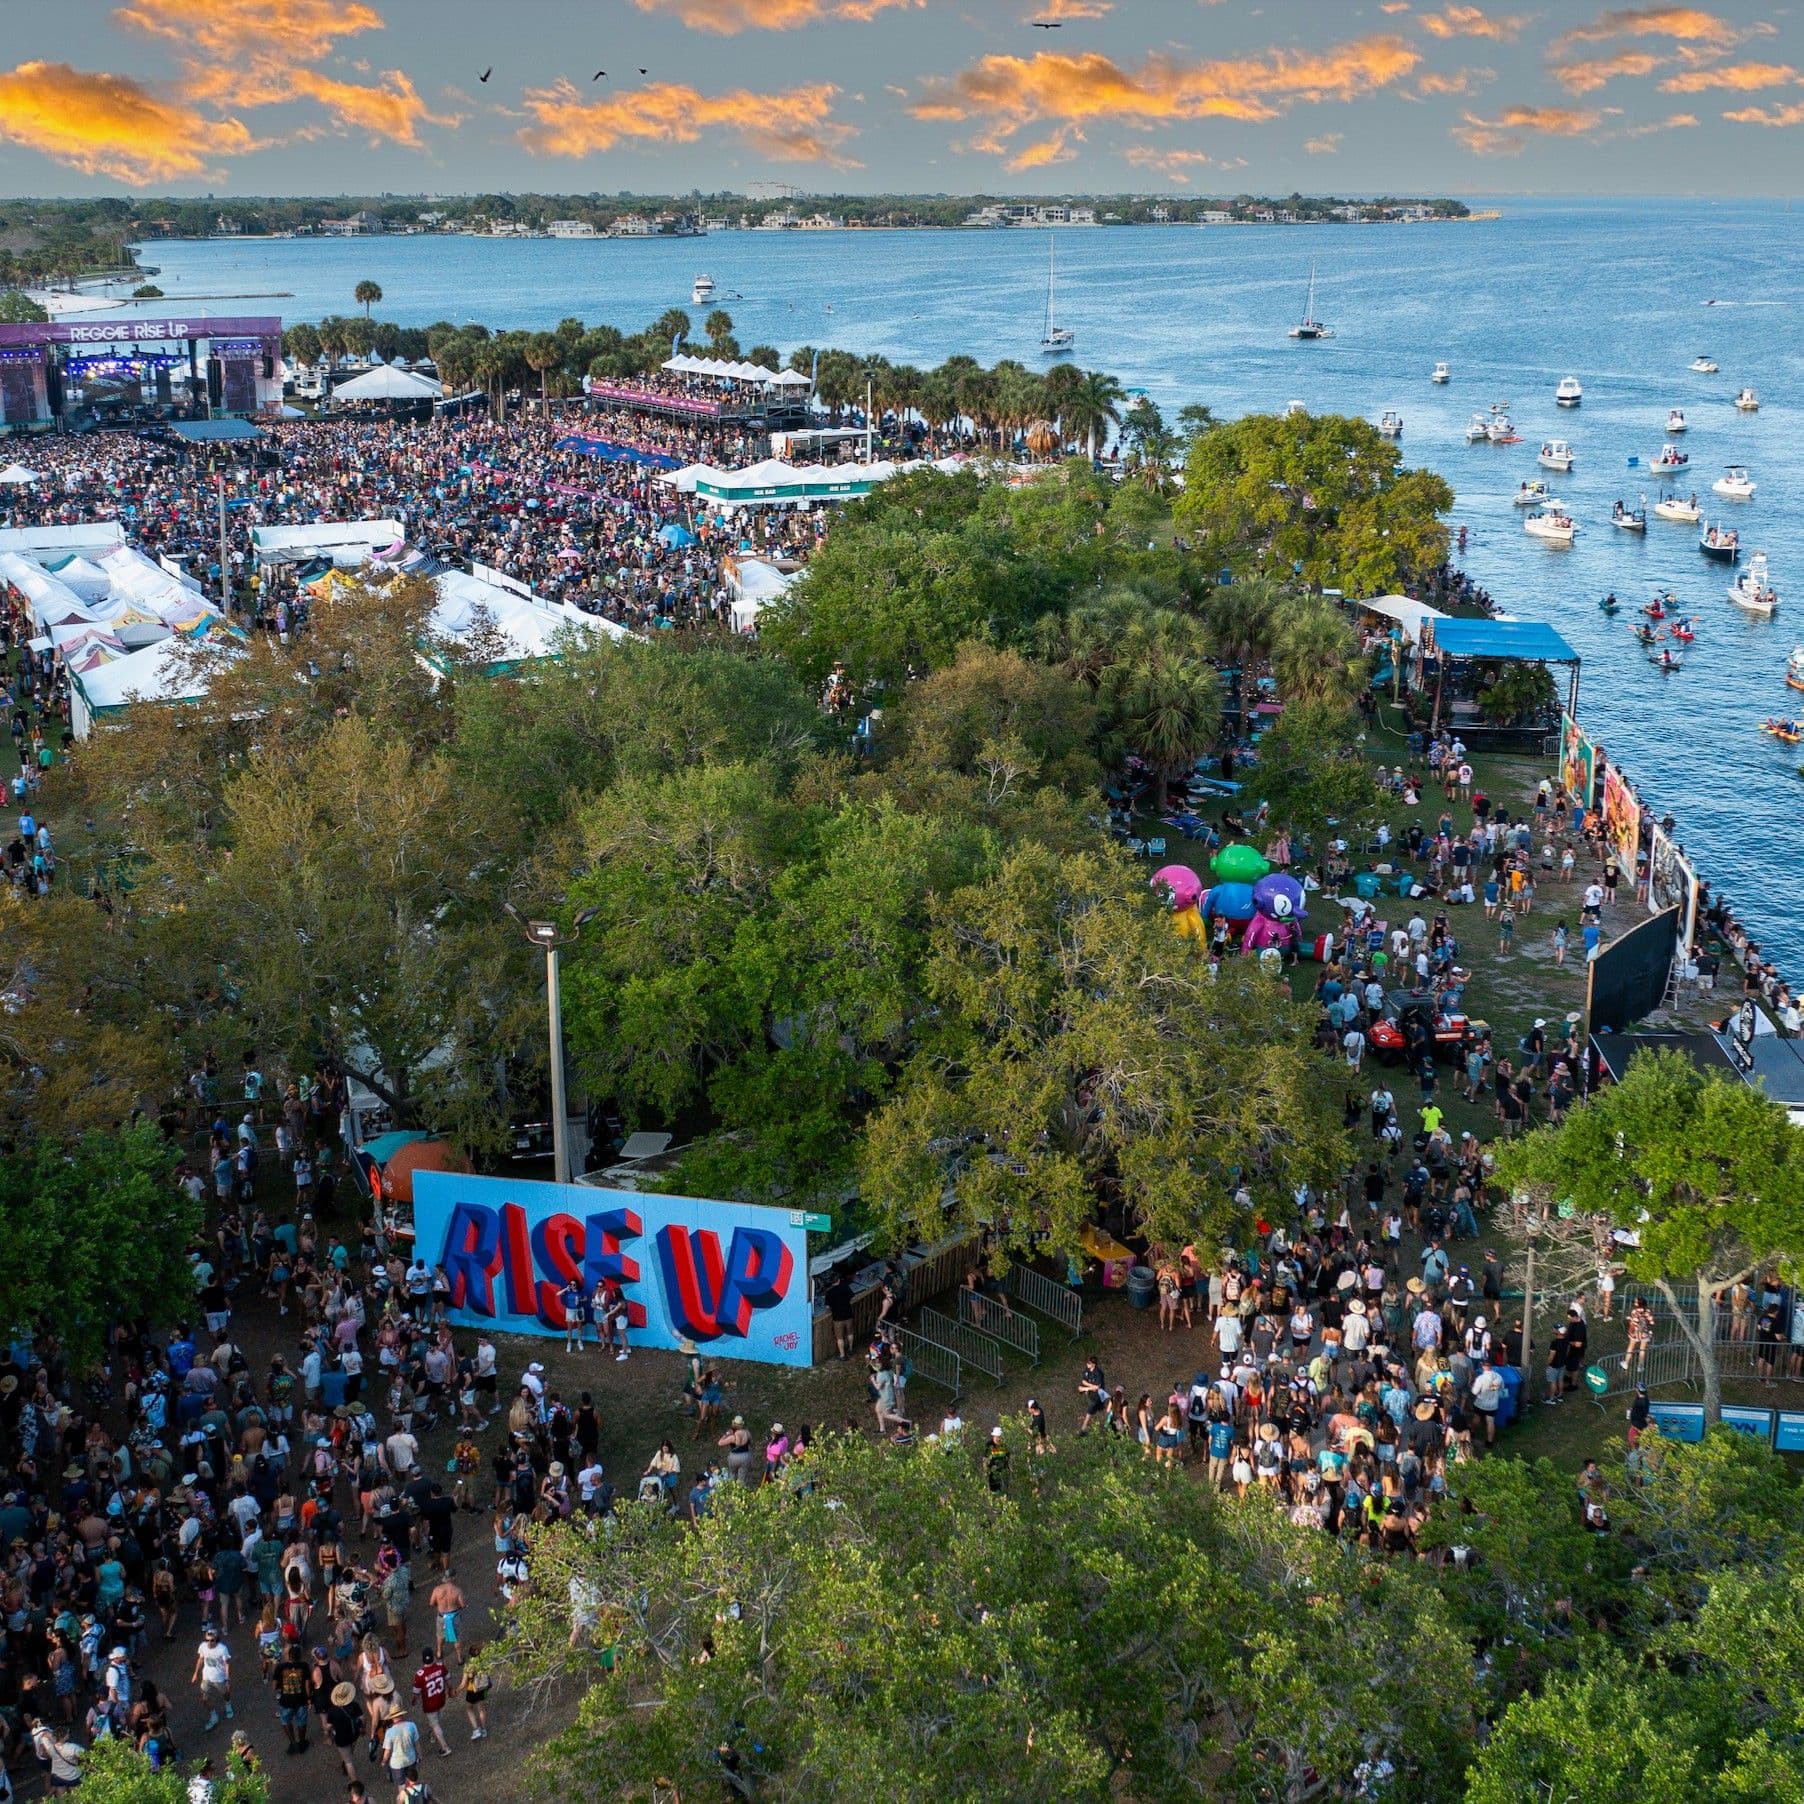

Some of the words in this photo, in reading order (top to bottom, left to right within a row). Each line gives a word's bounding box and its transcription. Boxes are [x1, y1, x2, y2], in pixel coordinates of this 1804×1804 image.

[71, 326, 129, 341] REGGAE
[135, 322, 164, 338] RISE
[169, 321, 188, 337] UP
[442, 1202, 646, 1331] RISE
[655, 1223, 794, 1343] UP
[783, 1341, 799, 1351] JOY
[426, 1677, 443, 1697] 23
